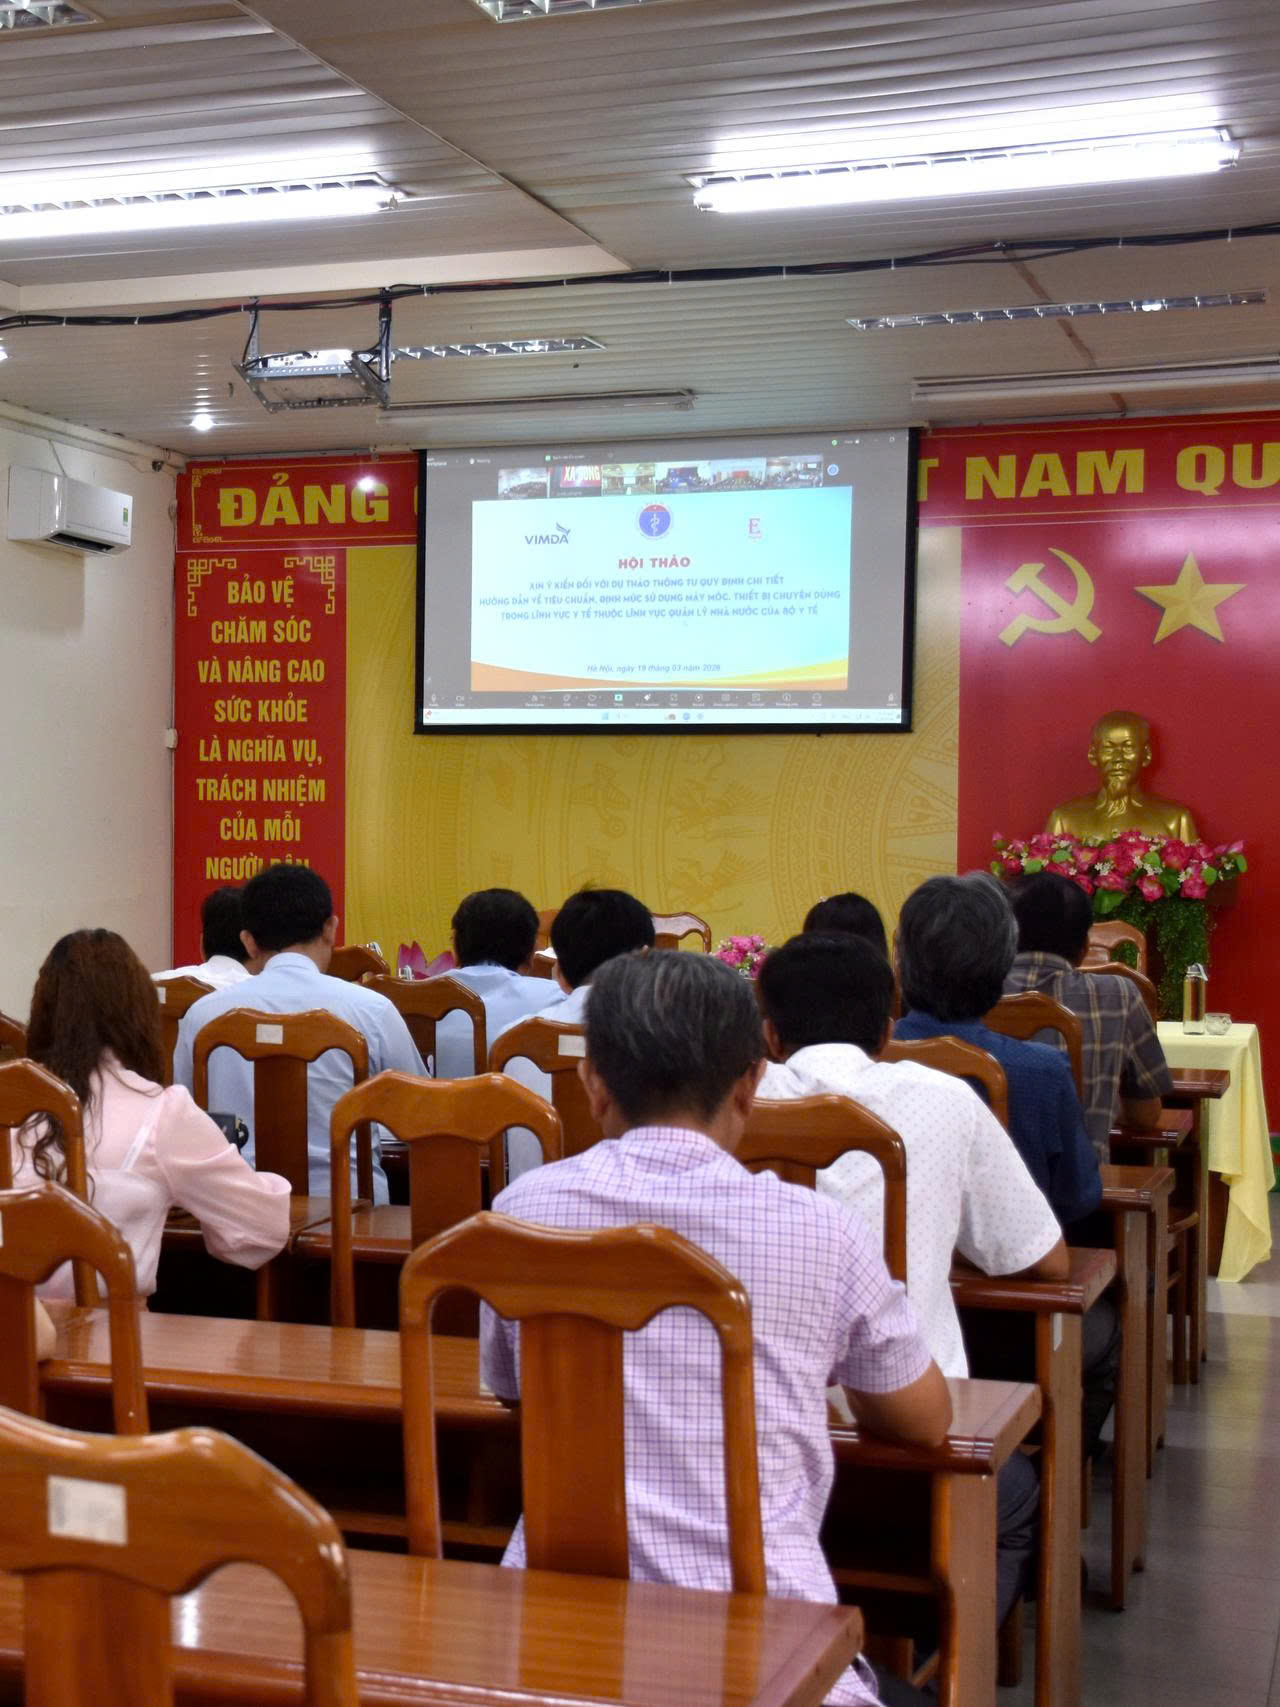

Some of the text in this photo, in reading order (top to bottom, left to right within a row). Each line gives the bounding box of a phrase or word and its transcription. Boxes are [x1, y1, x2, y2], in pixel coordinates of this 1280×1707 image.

[965, 449, 1145, 500] NAM
[217, 473, 389, 526] ĐẢNG
[525, 534, 570, 544] VIMDA
[619, 554, 690, 570] HỘI THẢO
[227, 574, 294, 608] BẢO VỆ
[211, 615, 311, 643] CHĂM SÓC
[198, 654, 325, 682] VÀ NÂNG CAO
[214, 692, 307, 722] SỨC KHỎE
[199, 735, 322, 767] LÀ NGHĨA VỤ,
[196, 773, 325, 806] TRÁCH NHIỆM
[220, 810, 300, 841] CỦA MỖI
